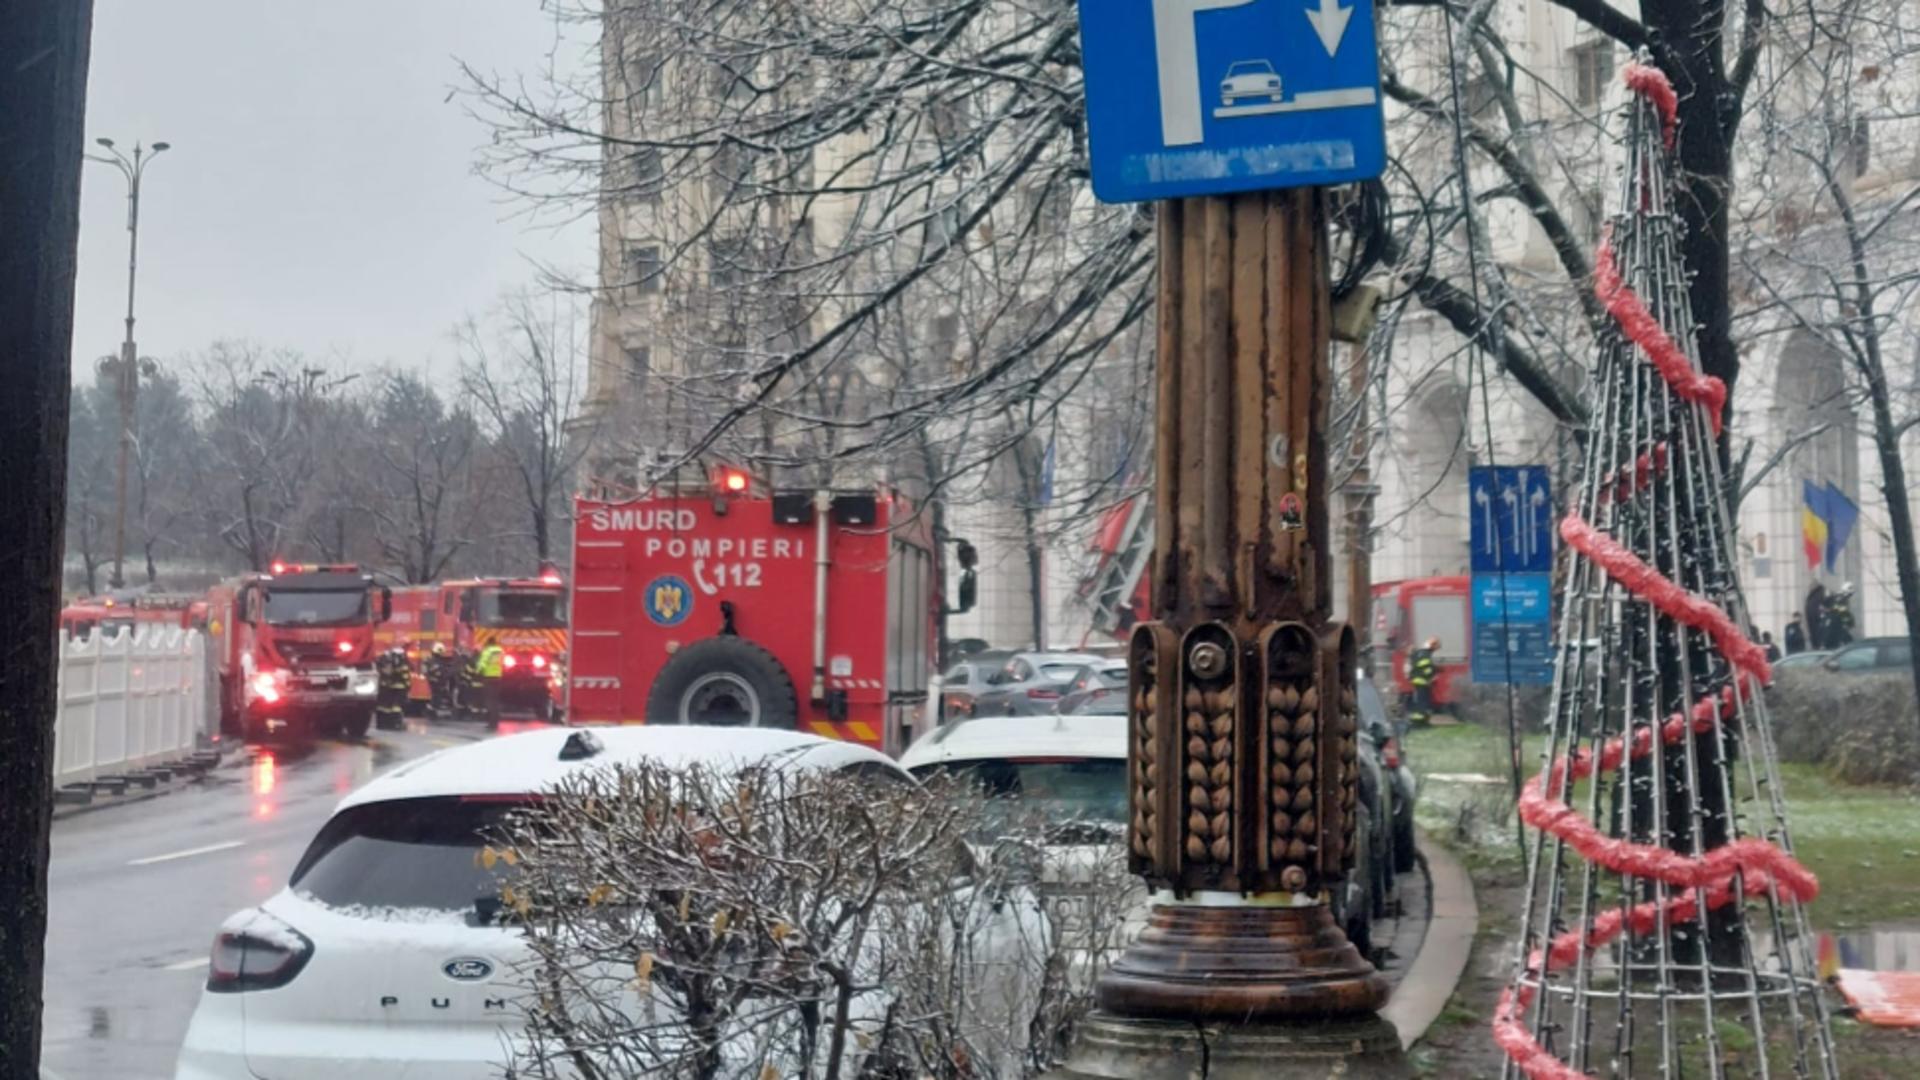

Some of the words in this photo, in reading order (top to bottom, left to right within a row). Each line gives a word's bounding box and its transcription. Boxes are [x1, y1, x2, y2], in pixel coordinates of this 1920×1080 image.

[592, 509, 697, 531] SMURD
[646, 538, 803, 558] POMPIERI
[713, 563, 762, 587] 112
[450, 961, 486, 977] Ford
[381, 996, 506, 1009] PUM
